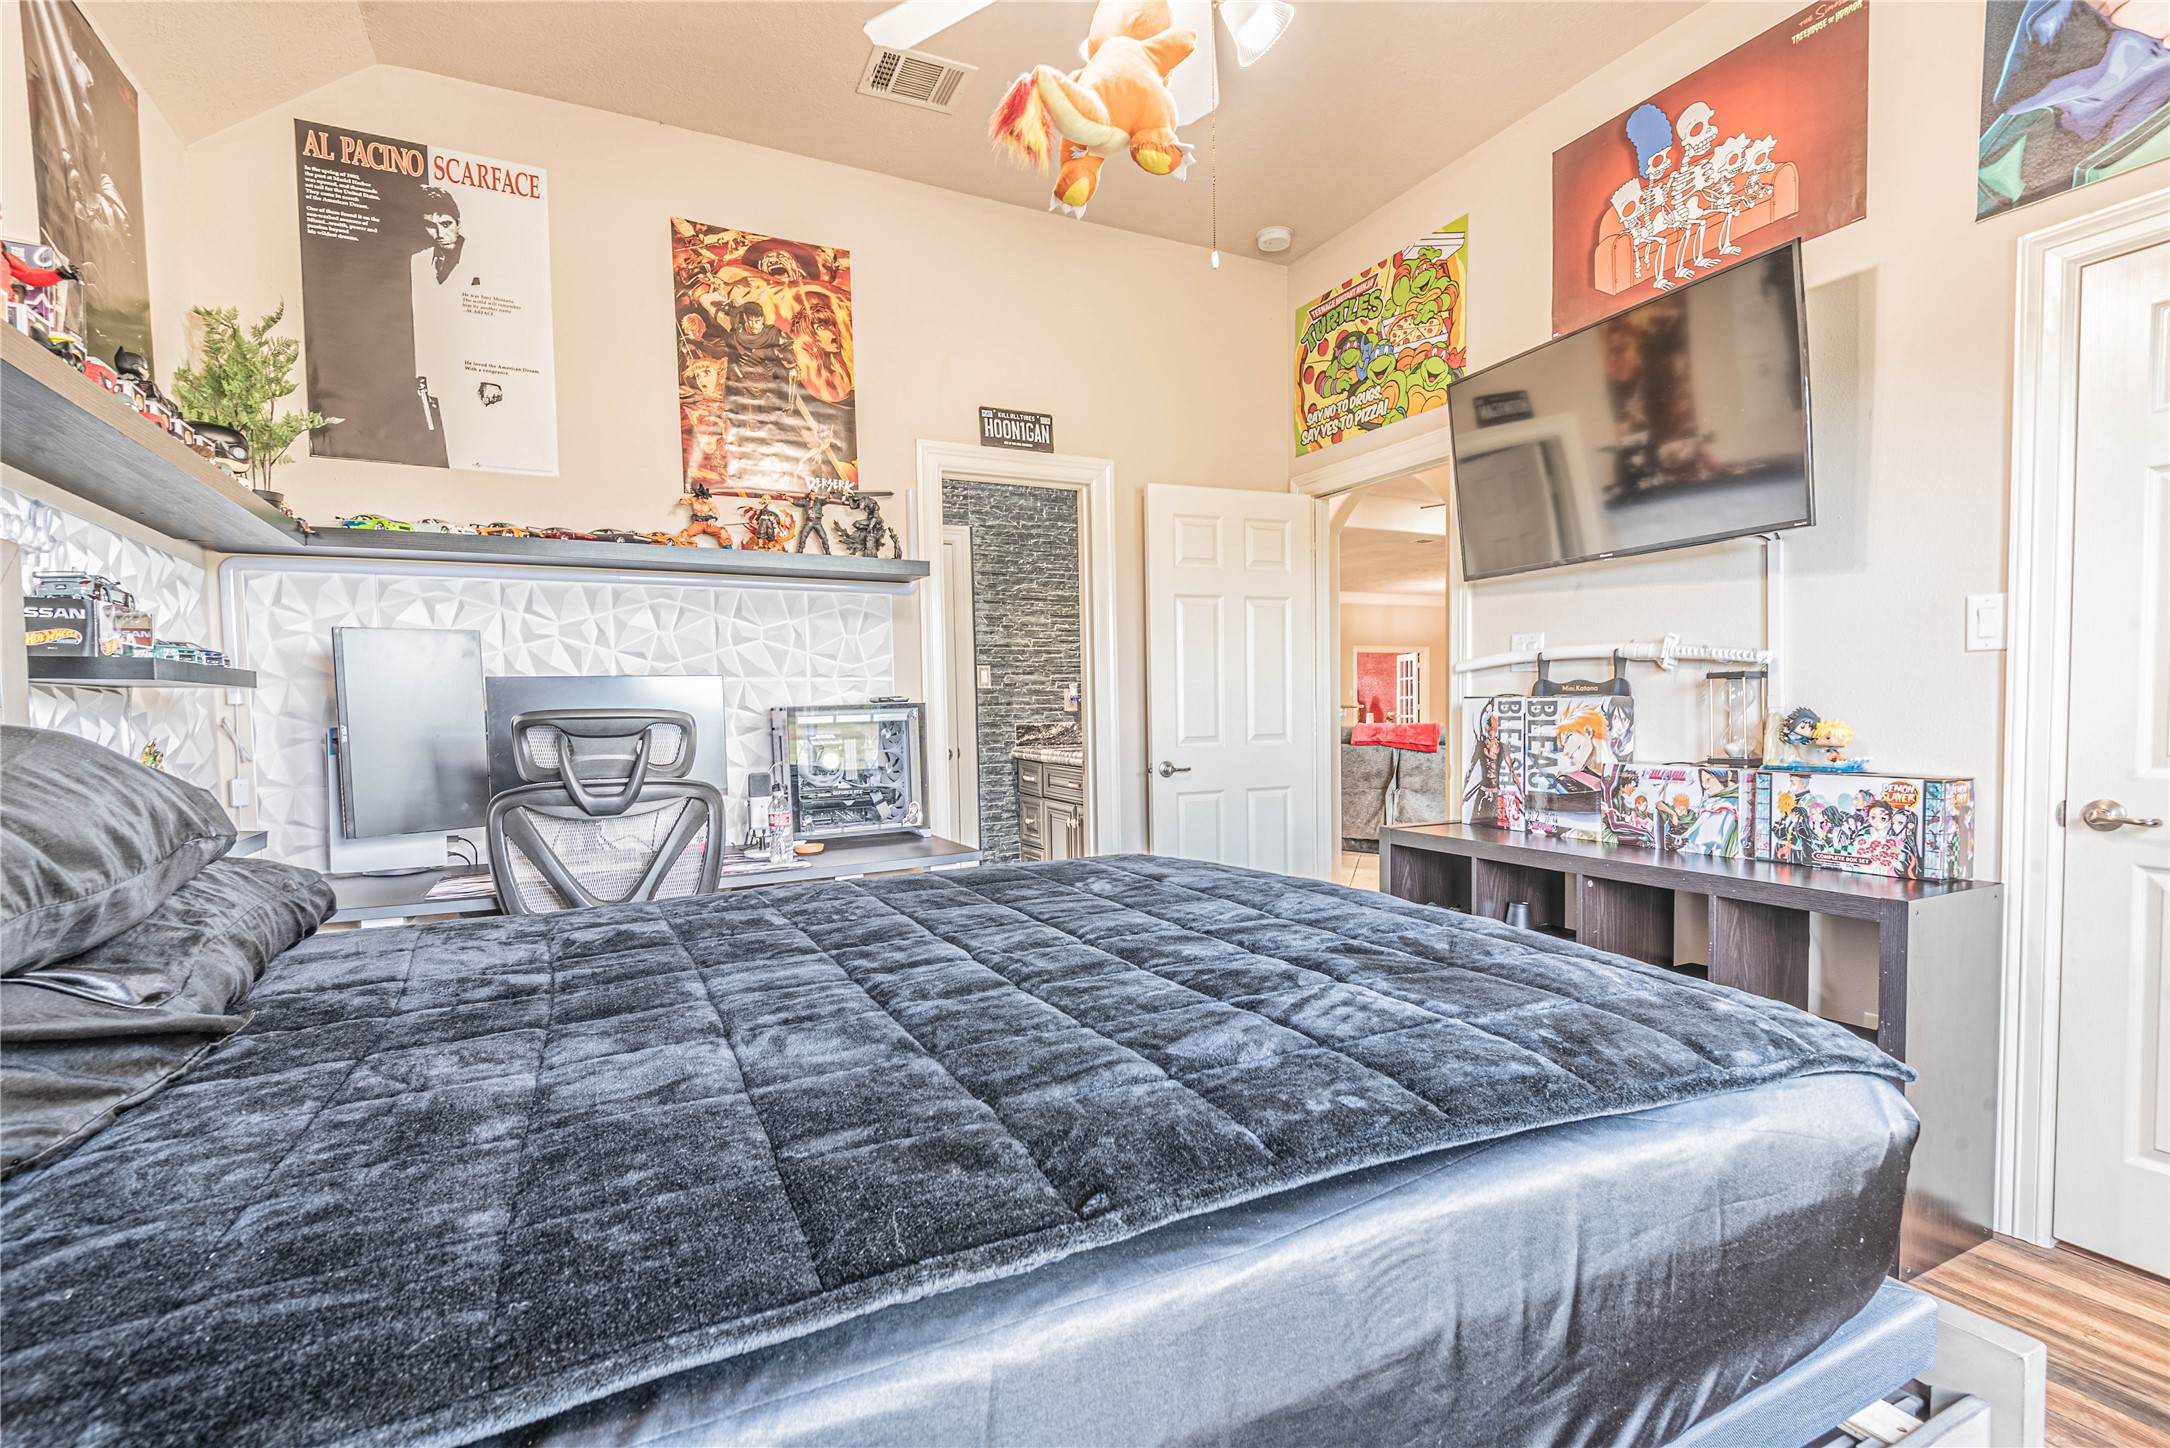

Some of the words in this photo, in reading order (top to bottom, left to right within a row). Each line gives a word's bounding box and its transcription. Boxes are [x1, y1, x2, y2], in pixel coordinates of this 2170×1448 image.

[1815, 0, 1848, 20] SIMPS
[1791, 18, 1828, 44] TREEHOUSE
[1835, 0, 1863, 22] HORROR
[303, 130, 334, 160] AL
[340, 136, 424, 177] PACINO
[322, 169, 339, 177] spring
[433, 155, 540, 199] SCARFACE
[351, 185, 378, 194] thousands
[323, 198, 349, 206] American
[329, 226, 350, 234] beyond
[1311, 300, 1336, 318] TEENAGE
[1336, 287, 1357, 305] MUTANT
[1301, 289, 1383, 353] TURTLES
[1301, 427, 1320, 446] SAY
[1320, 419, 1339, 439] YES
[1340, 413, 1354, 431] TO
[1355, 398, 1389, 426] PIZZA!
[1307, 409, 1324, 426] SAY
[1324, 404, 1336, 420] NO
[1337, 399, 1349, 414] TO
[804, 474, 856, 497] BERSERK
[24, 607, 86, 620] SSAN
[1882, 792, 1915, 803] SLAYER
[1883, 783, 1915, 794] DEMON
[1816, 853, 1844, 861] COMPLETE
